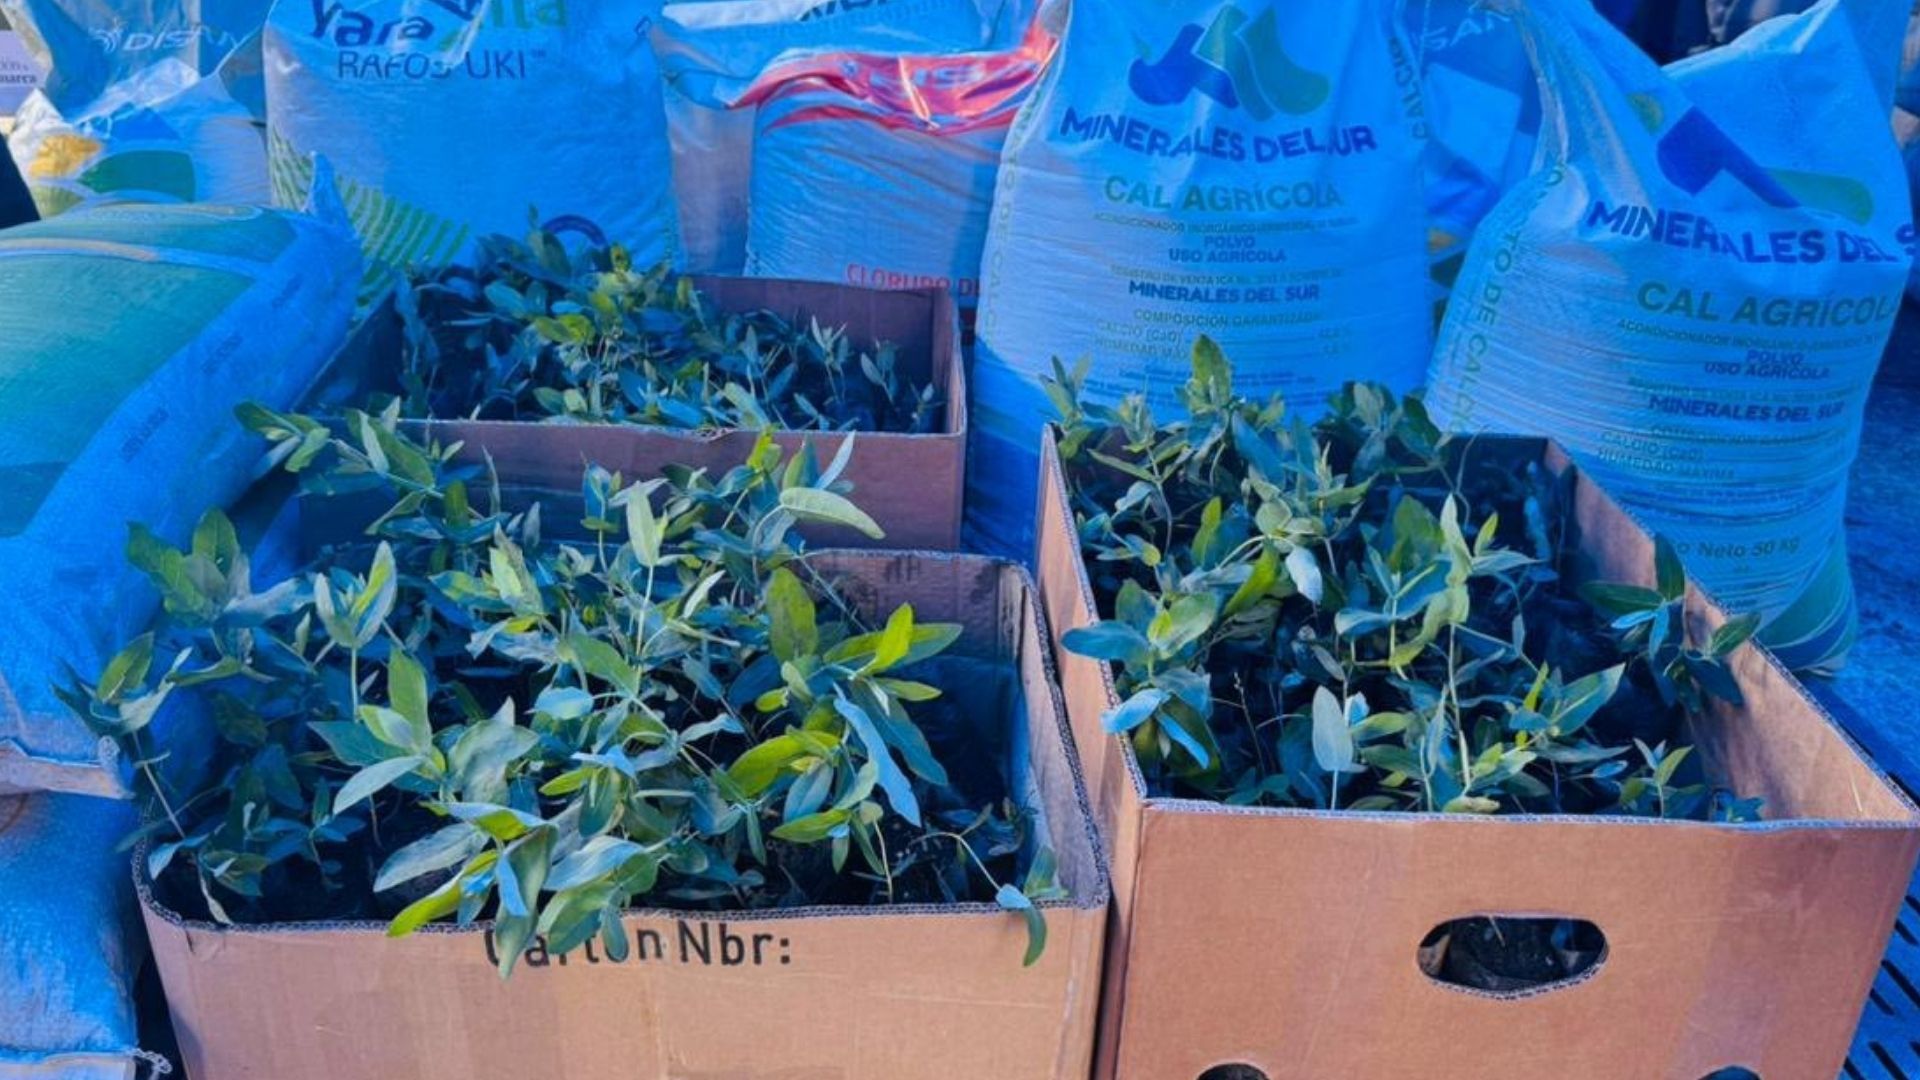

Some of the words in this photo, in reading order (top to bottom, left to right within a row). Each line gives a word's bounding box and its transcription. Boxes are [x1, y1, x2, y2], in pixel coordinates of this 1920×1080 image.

[1060, 106, 1246, 162] MINERALES
[1254, 127, 1332, 163] DEL
[1104, 175, 1171, 209] CAL
[1203, 235, 1256, 249] POLVO
[1587, 201, 1828, 263] MINERALES
[1836, 230, 1899, 263] DEL
[1168, 248, 1201, 264] USO
[1128, 279, 1243, 302] MINERALES
[1246, 286, 1277, 301] DEL
[1285, 284, 1320, 301] SUR
[1477, 282, 1503, 326] DE
[1637, 280, 1721, 321] CAL
[1729, 288, 1902, 328] AGRÍCOL
[1704, 361, 1742, 375] USO
[1746, 349, 1804, 366] POLVO
[1648, 395, 1772, 422] MINERALES
[1774, 404, 1810, 423] DEL
[1699, 540, 1747, 559] Neto
[677, 920, 791, 966] Nbr:
